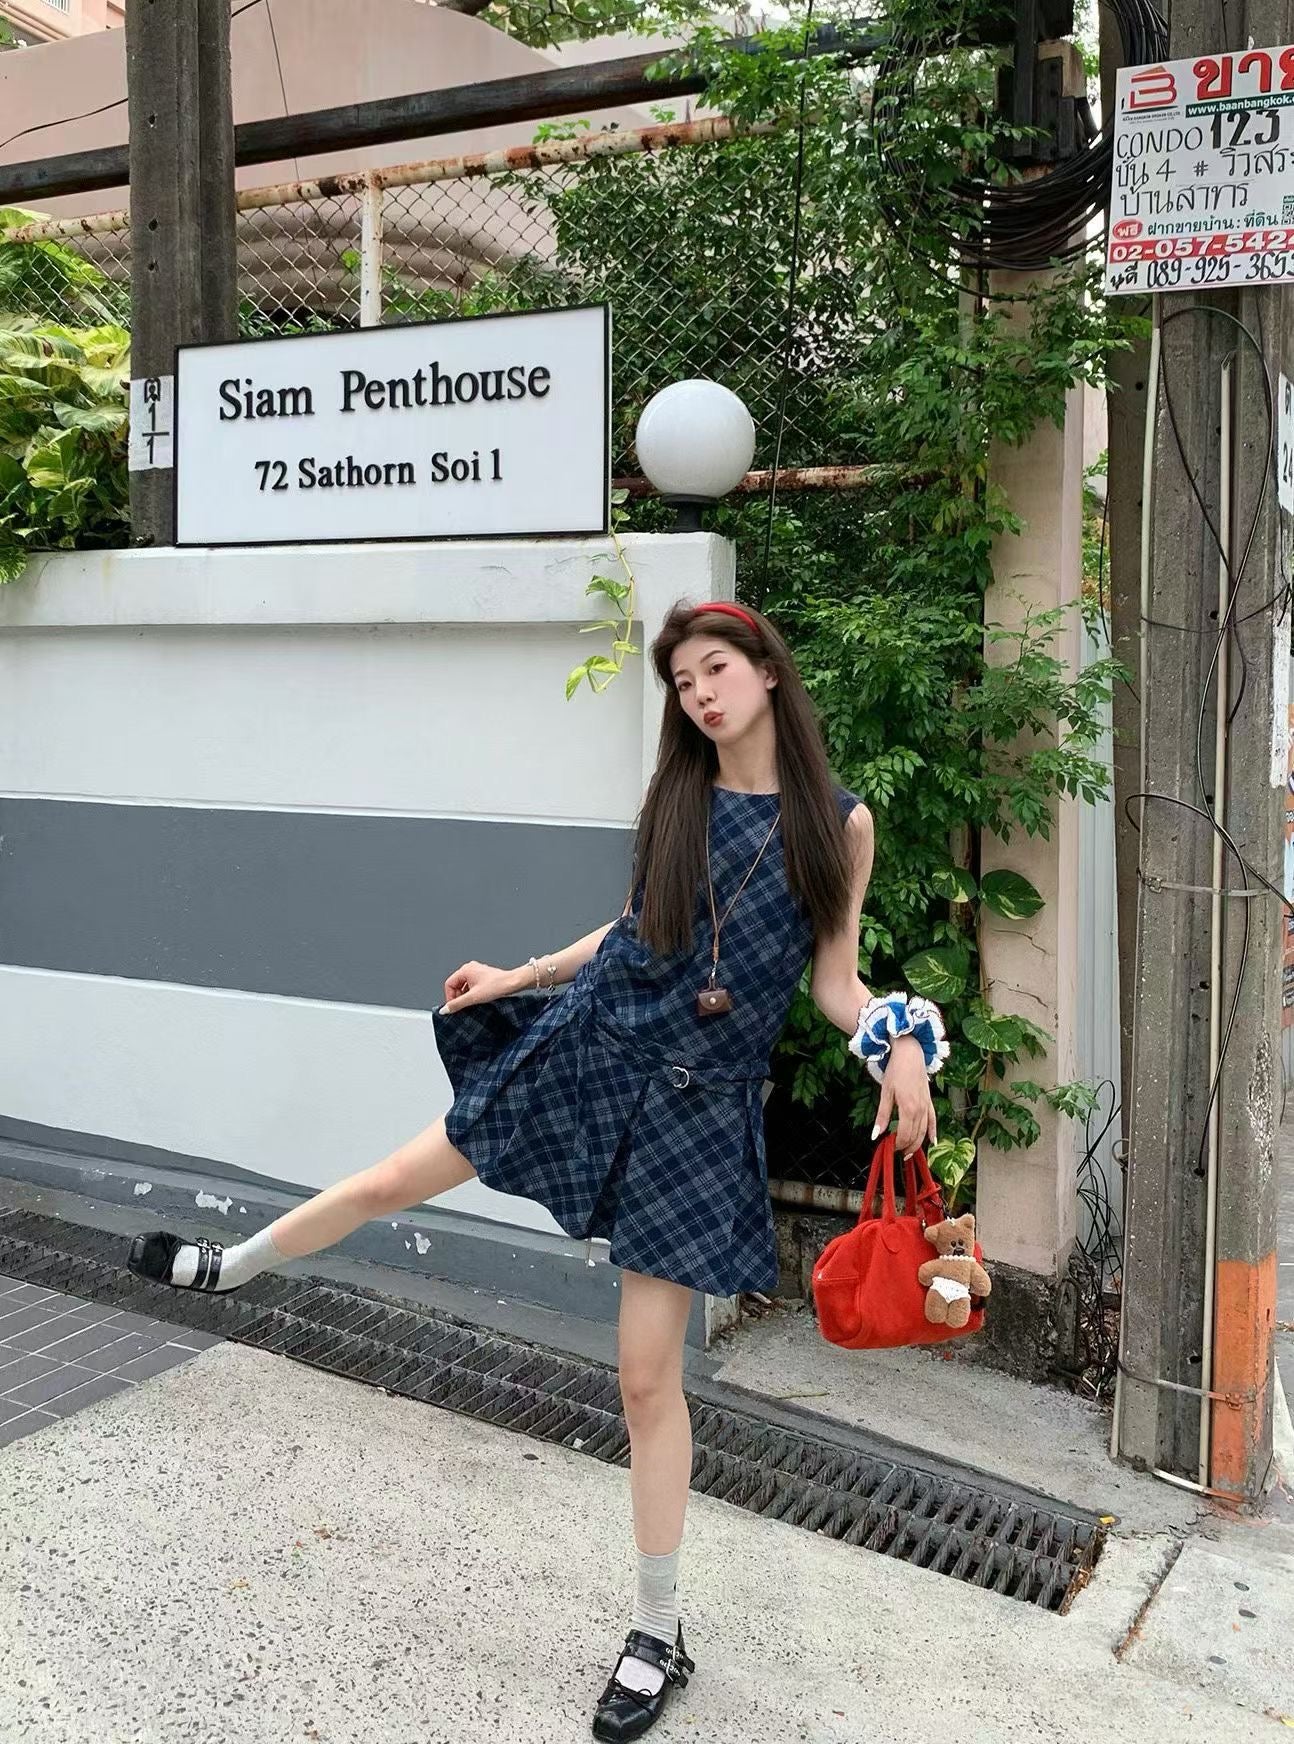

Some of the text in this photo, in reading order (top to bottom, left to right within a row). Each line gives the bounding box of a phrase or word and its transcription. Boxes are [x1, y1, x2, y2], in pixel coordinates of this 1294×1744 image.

[1117, 109, 1280, 158] CONDO 123
[1156, 158, 1176, 182] 4
[219, 361, 551, 420] Siam Penthouse
[254, 460, 289, 491] 72
[298, 455, 416, 488] Sathorn
[431, 450, 481, 482] Soi
